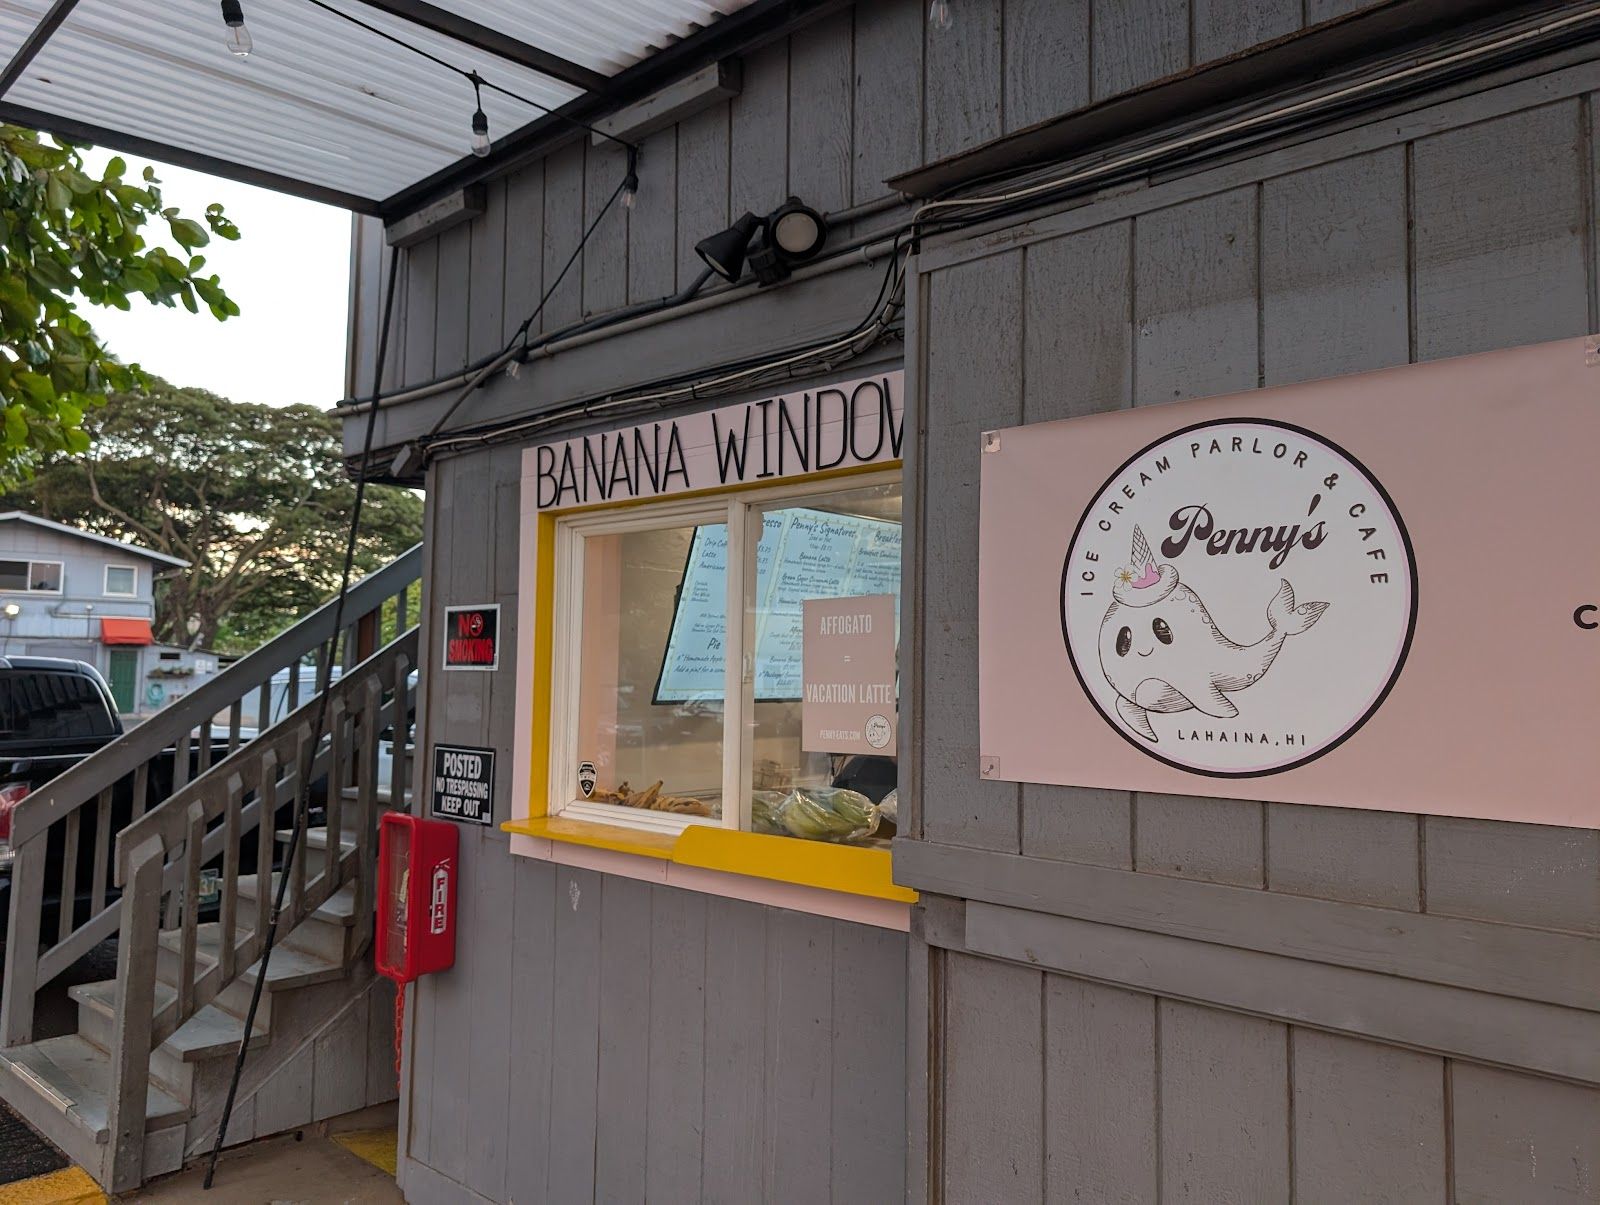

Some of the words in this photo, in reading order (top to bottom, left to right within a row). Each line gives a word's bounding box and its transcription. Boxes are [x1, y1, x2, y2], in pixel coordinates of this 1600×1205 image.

[536, 421, 691, 510] BANANA
[791, 517, 818, 534] Penny's
[820, 521, 857, 538] Signatures
[1080, 551, 1099, 596] ICE
[1098, 456, 1171, 532] CREAM
[1190, 436, 1308, 469] PARLOR
[1323, 473, 1339, 490] &
[1348, 503, 1389, 585] CAFE
[1160, 493, 1329, 571] Penny's
[457, 613, 483, 637] NO
[820, 614, 872, 635] AFFOGATO
[448, 638, 493, 664] SMOKING
[707, 637, 721, 650] Pie
[806, 684, 856, 704] VACATION
[859, 684, 892, 704] LATTE
[443, 752, 482, 779] POSTED
[435, 776, 446, 793] NO
[446, 777, 489, 800] TRESPASSING
[441, 795, 462, 814] KEEP
[463, 798, 481, 817] OUT
[434, 877, 448, 929] FIRE
